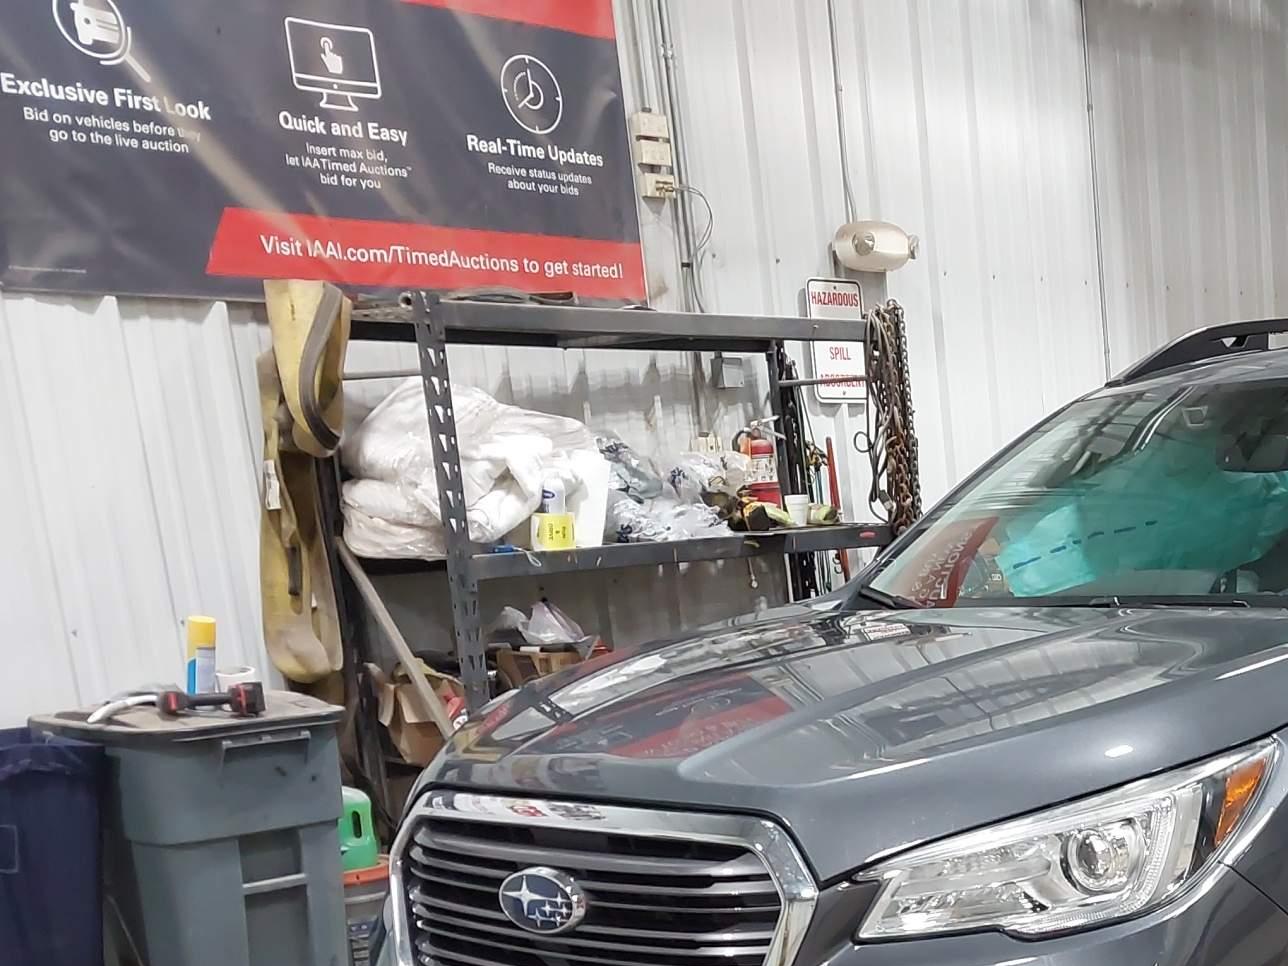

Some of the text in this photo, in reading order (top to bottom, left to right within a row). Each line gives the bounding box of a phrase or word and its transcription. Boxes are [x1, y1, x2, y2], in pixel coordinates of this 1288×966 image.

[0, 72, 212, 120] Exclusive First Look
[23, 107, 49, 122] Bid
[53, 112, 72, 125] on
[75, 114, 130, 132] vehicles
[133, 120, 175, 138] before
[278, 111, 408, 147] Quick and Easy
[49, 129, 190, 153] go to the live auction
[466, 134, 604, 167] Real-Time Updates
[286, 153, 300, 166] let
[306, 142, 388, 163] Insert max bid,
[320, 173, 382, 190] bid for you
[488, 162, 592, 184] Receive status updates
[508, 179, 579, 196] about your bids
[260, 234, 624, 279] Visit IAAI.com/TimedAuctions to get started!
[811, 291, 859, 307] HAZARDOUS
[829, 346, 851, 360] SPILL
